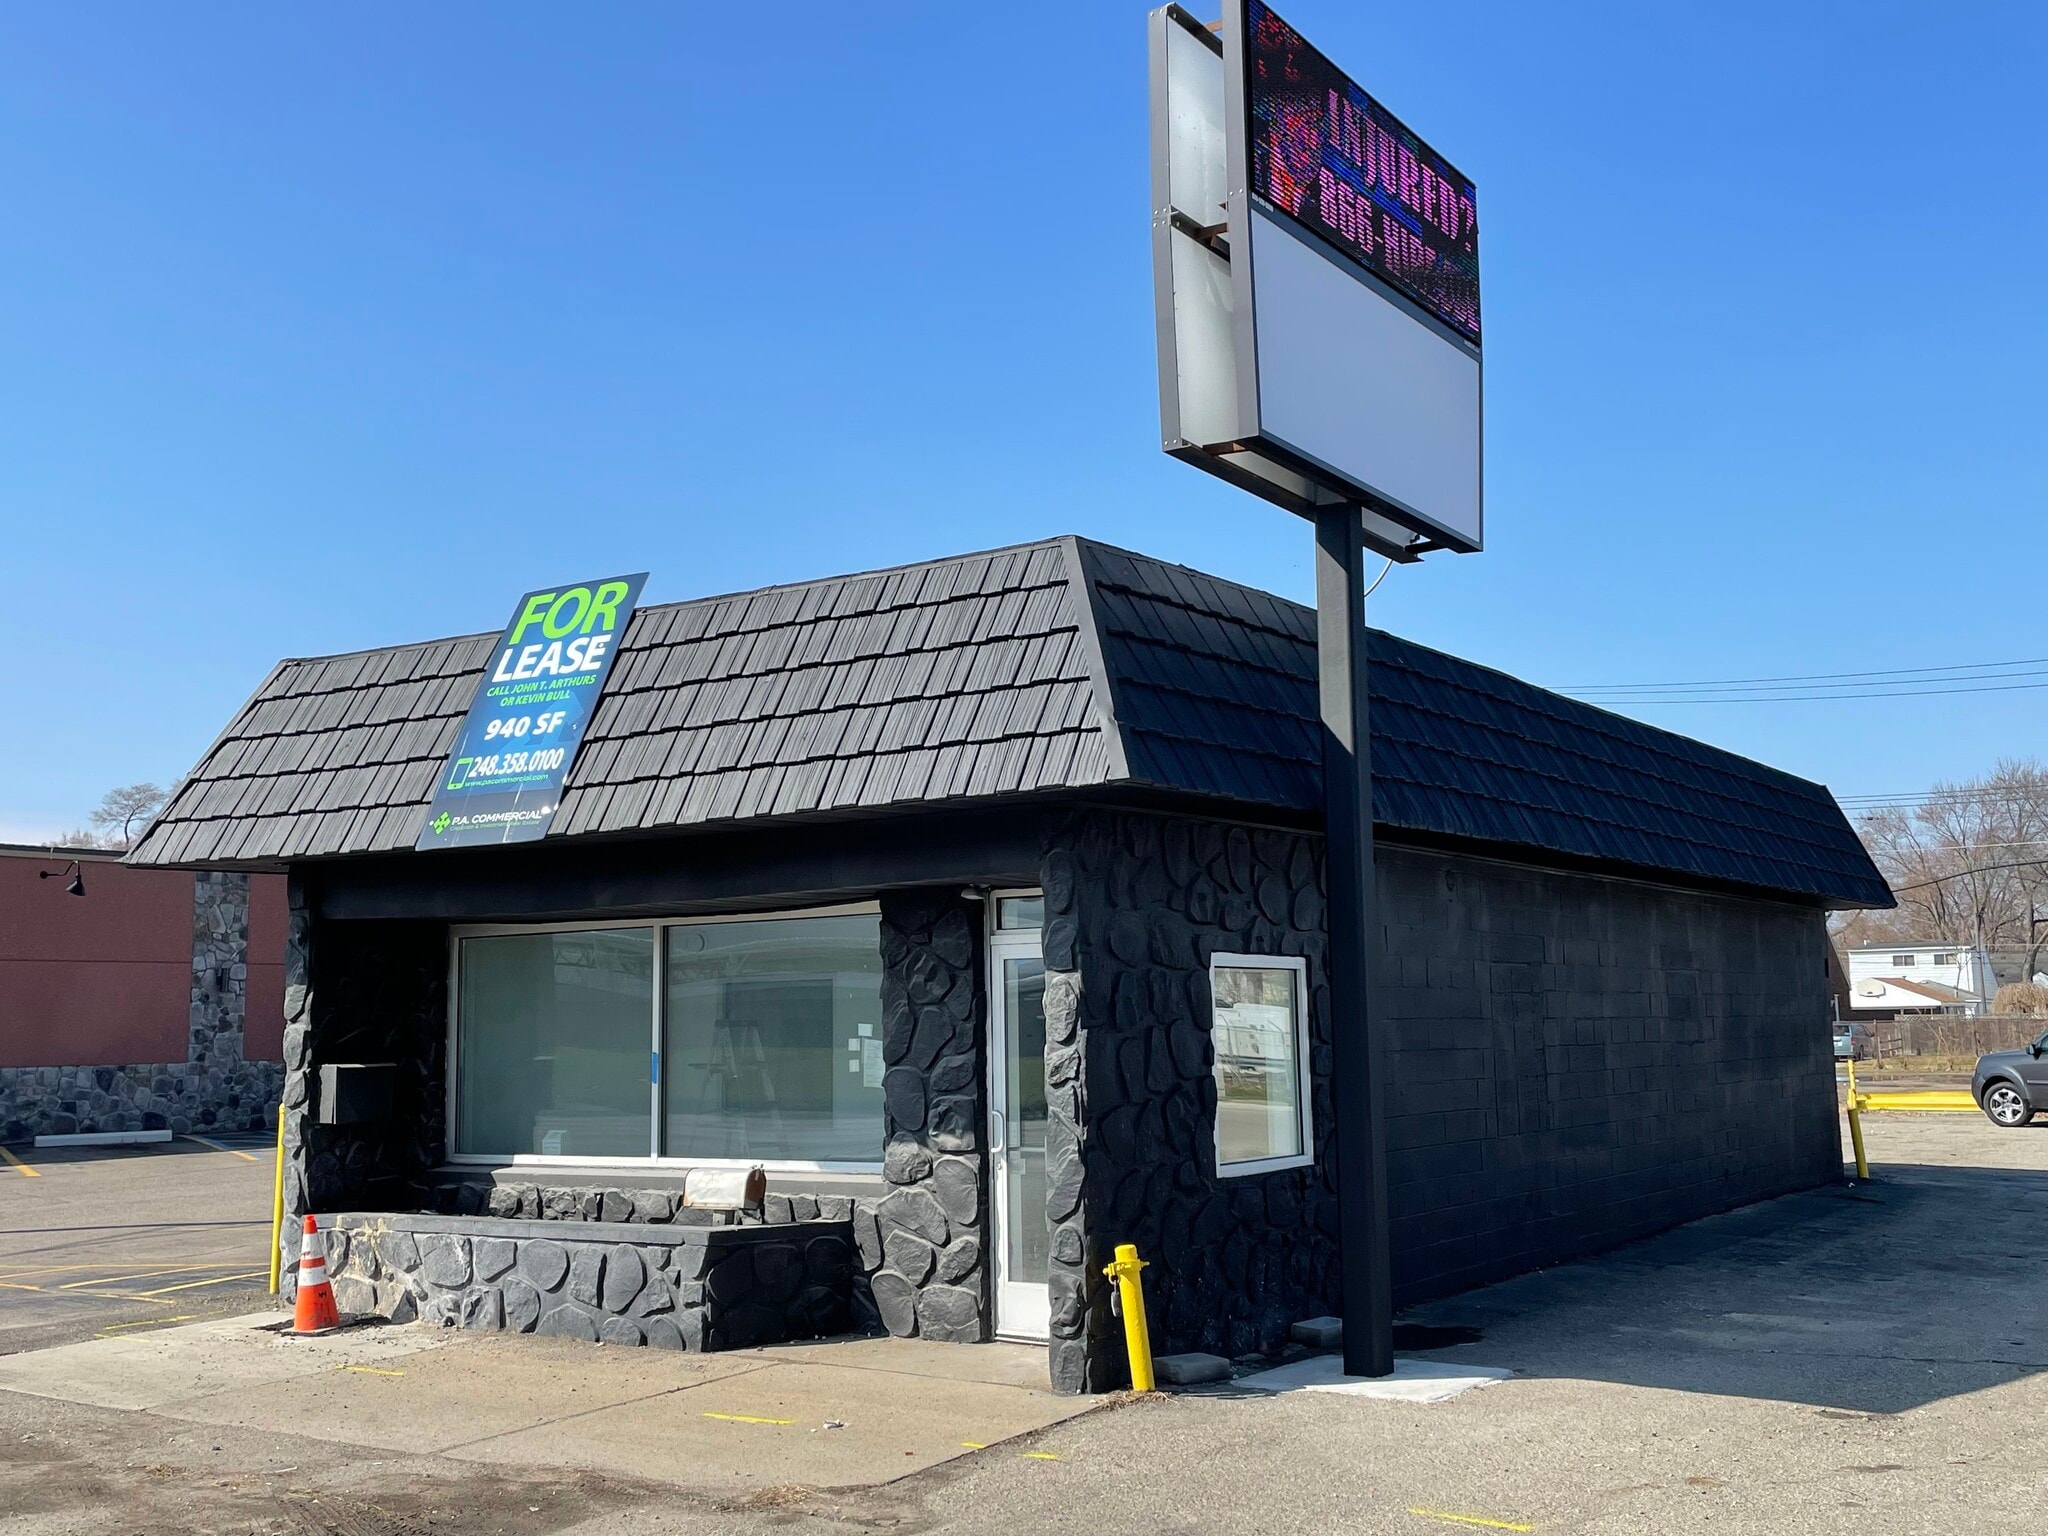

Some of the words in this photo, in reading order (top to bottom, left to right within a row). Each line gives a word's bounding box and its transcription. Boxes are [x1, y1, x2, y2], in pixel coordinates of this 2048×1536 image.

[1328, 88, 1475, 252] INJURED?
[508, 581, 629, 646] FOR
[491, 634, 612, 683] LEASE
[486, 687, 510, 697] CALL
[511, 682, 539, 694] JOHN
[540, 681, 548, 690] T.
[549, 674, 597, 688] ARTHURS
[500, 698, 515, 707] OR
[515, 693, 546, 706] KEVIN
[547, 690, 571, 702] BULL
[483, 716, 531, 741] 940
[532, 710, 567, 736] SF
[468, 747, 565, 778] 248.358.0100
[471, 810, 542, 824] COMMERCIAL
